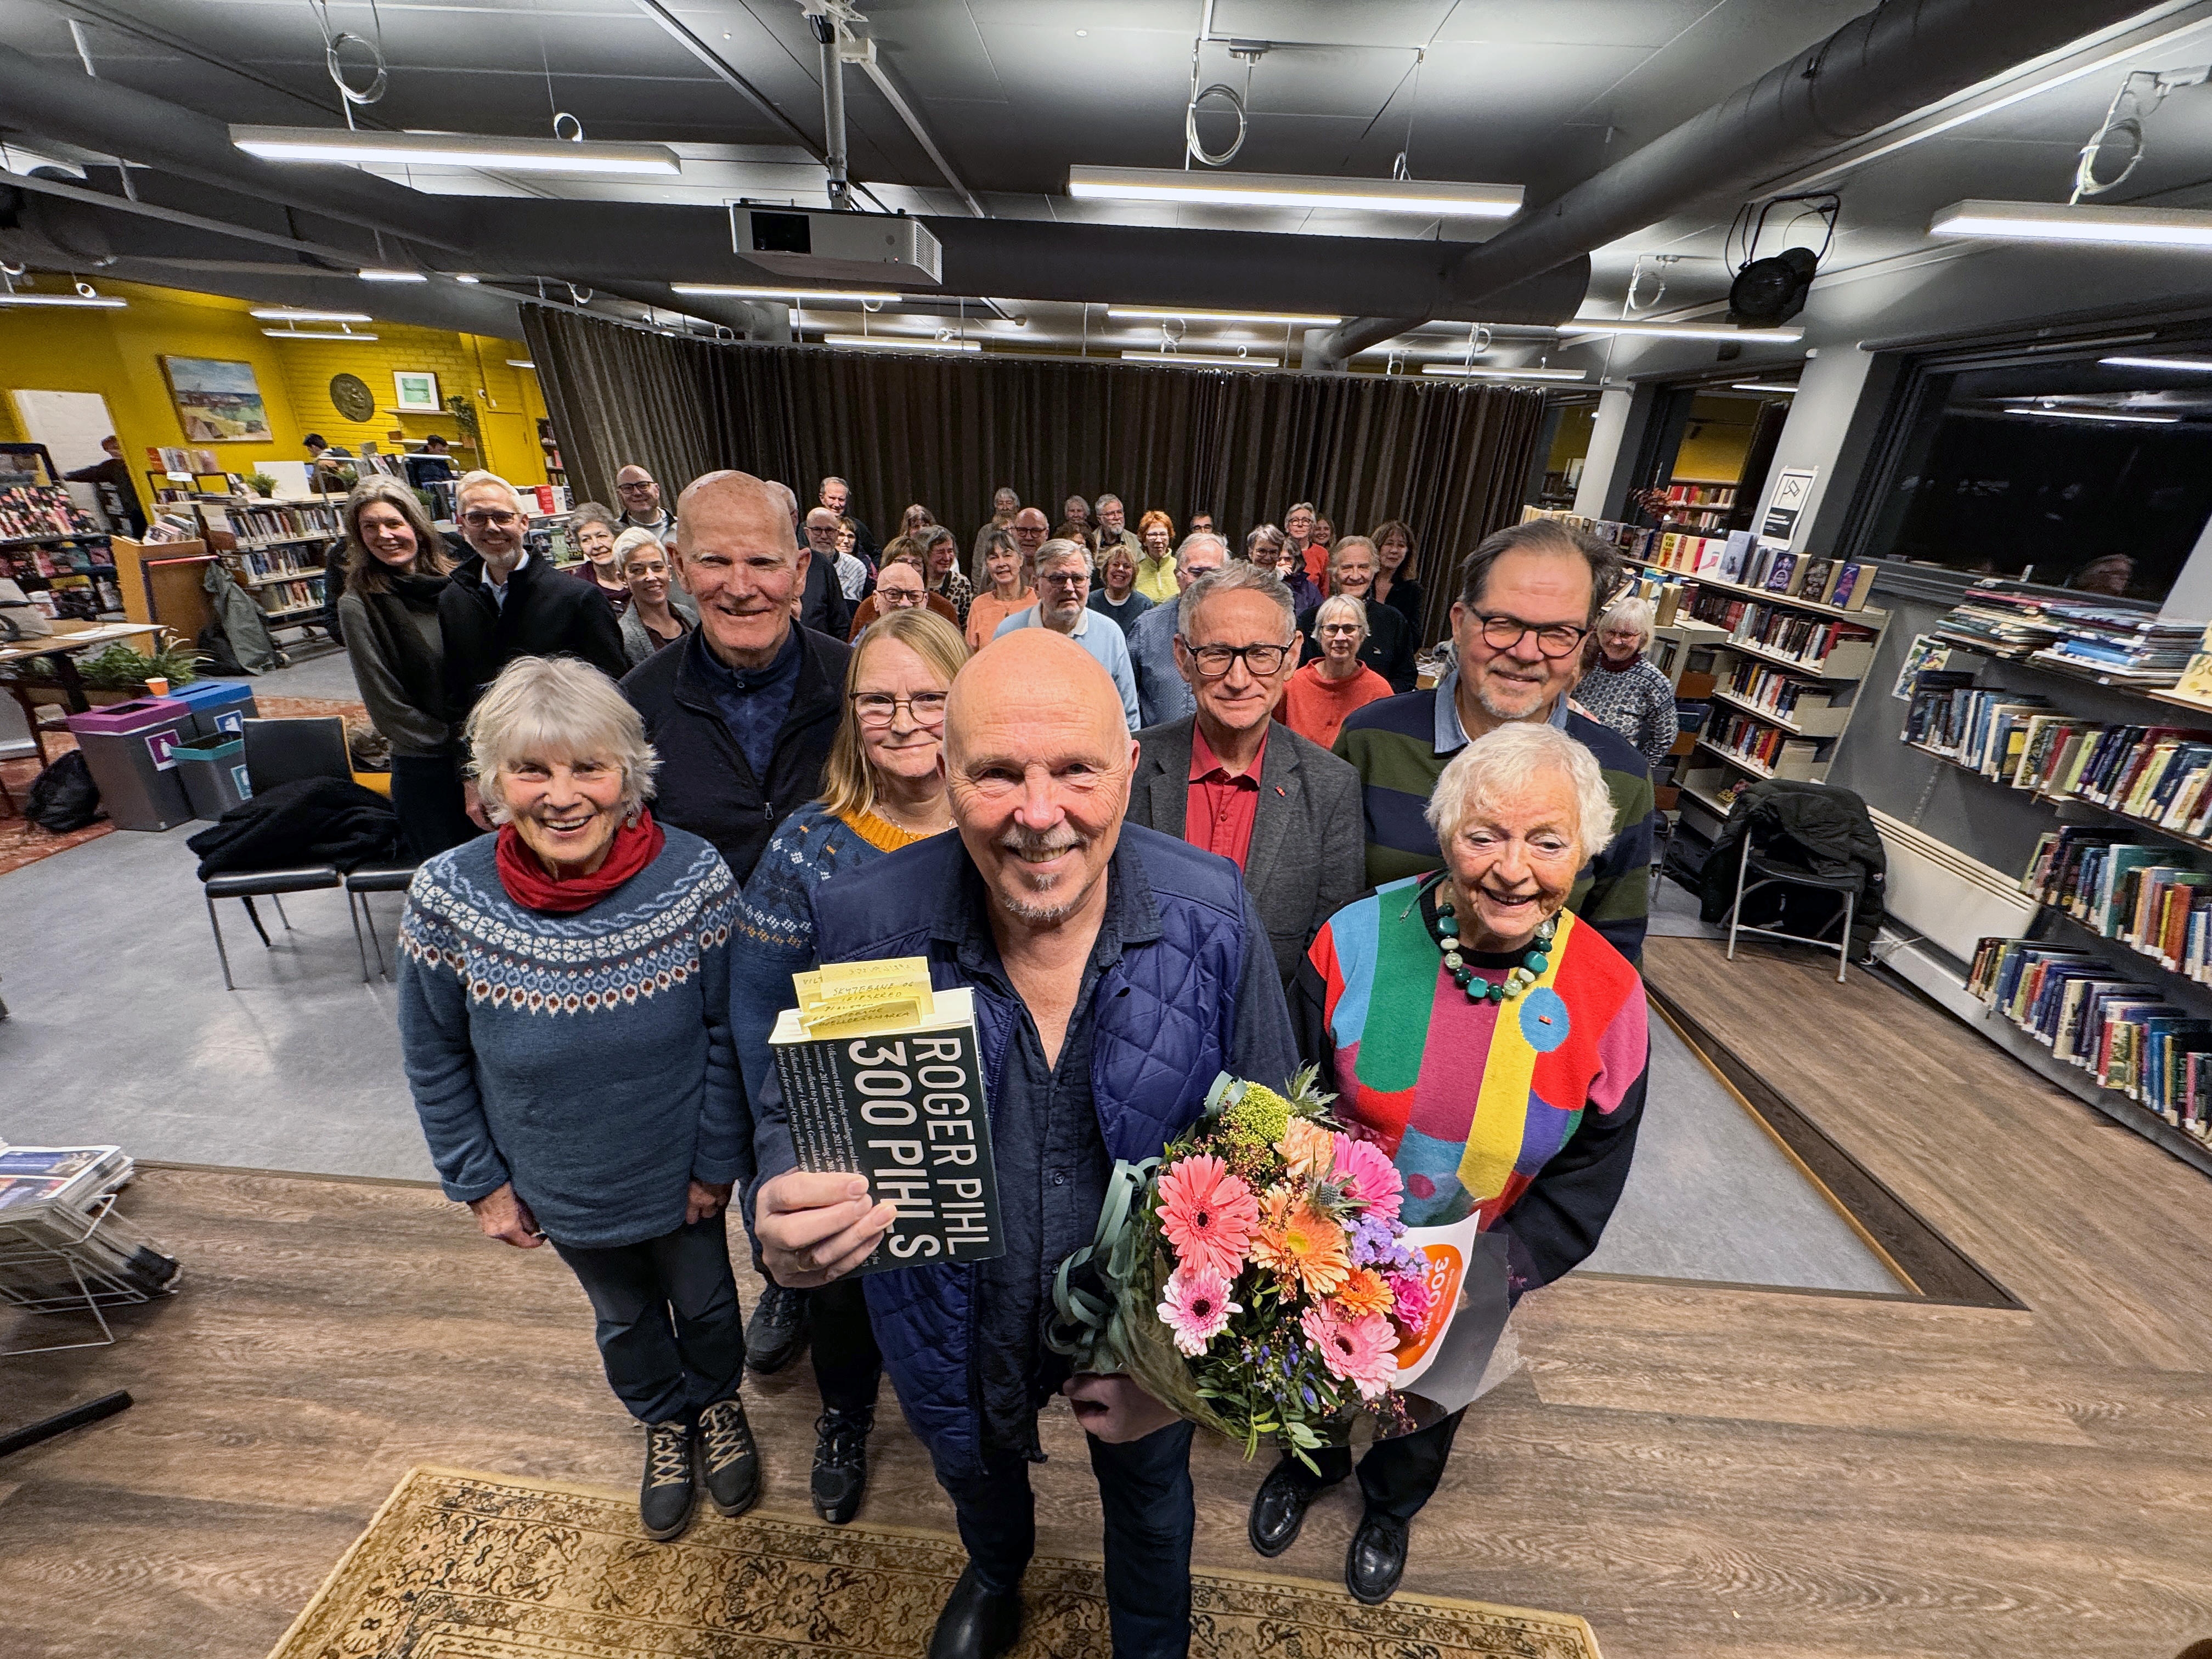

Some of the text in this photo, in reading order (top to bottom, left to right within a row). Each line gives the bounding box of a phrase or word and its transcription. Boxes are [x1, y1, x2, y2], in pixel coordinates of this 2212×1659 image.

[789, 1047, 802, 1073] Kielland
[801, 1046, 812, 1066] samlet
[814, 1045, 825, 1071] nummer
[827, 1043, 838, 1079] Velkommen
[775, 1047, 785, 1066] skrive
[790, 1111, 798, 1122] Om
[794, 1075, 805, 1093] senior
[806, 1067, 816, 1090] mellom
[819, 1073, 829, 1084] 201
[849, 1040, 917, 1125] 300
[822, 1085, 833, 1103] datert
[835, 1087, 845, 1098] den
[799, 1098, 809, 1116] Akers
[838, 1099, 849, 1116] tredje
[803, 1116, 813, 1129] Avis
[817, 1121, 826, 1129] En
[827, 1110, 839, 1132] oktober
[843, 1116, 853, 1146] samlingen
[806, 1131, 822, 1167] Groruddalen
[822, 1130, 832, 1156] vinterdag
[833, 1133, 843, 1147] 2021
[912, 1038, 990, 1255] ROGER PIHL
[848, 1146, 859, 1158] med
[851, 1159, 862, 1174] hund
[867, 1140, 941, 1258] PIHLS
